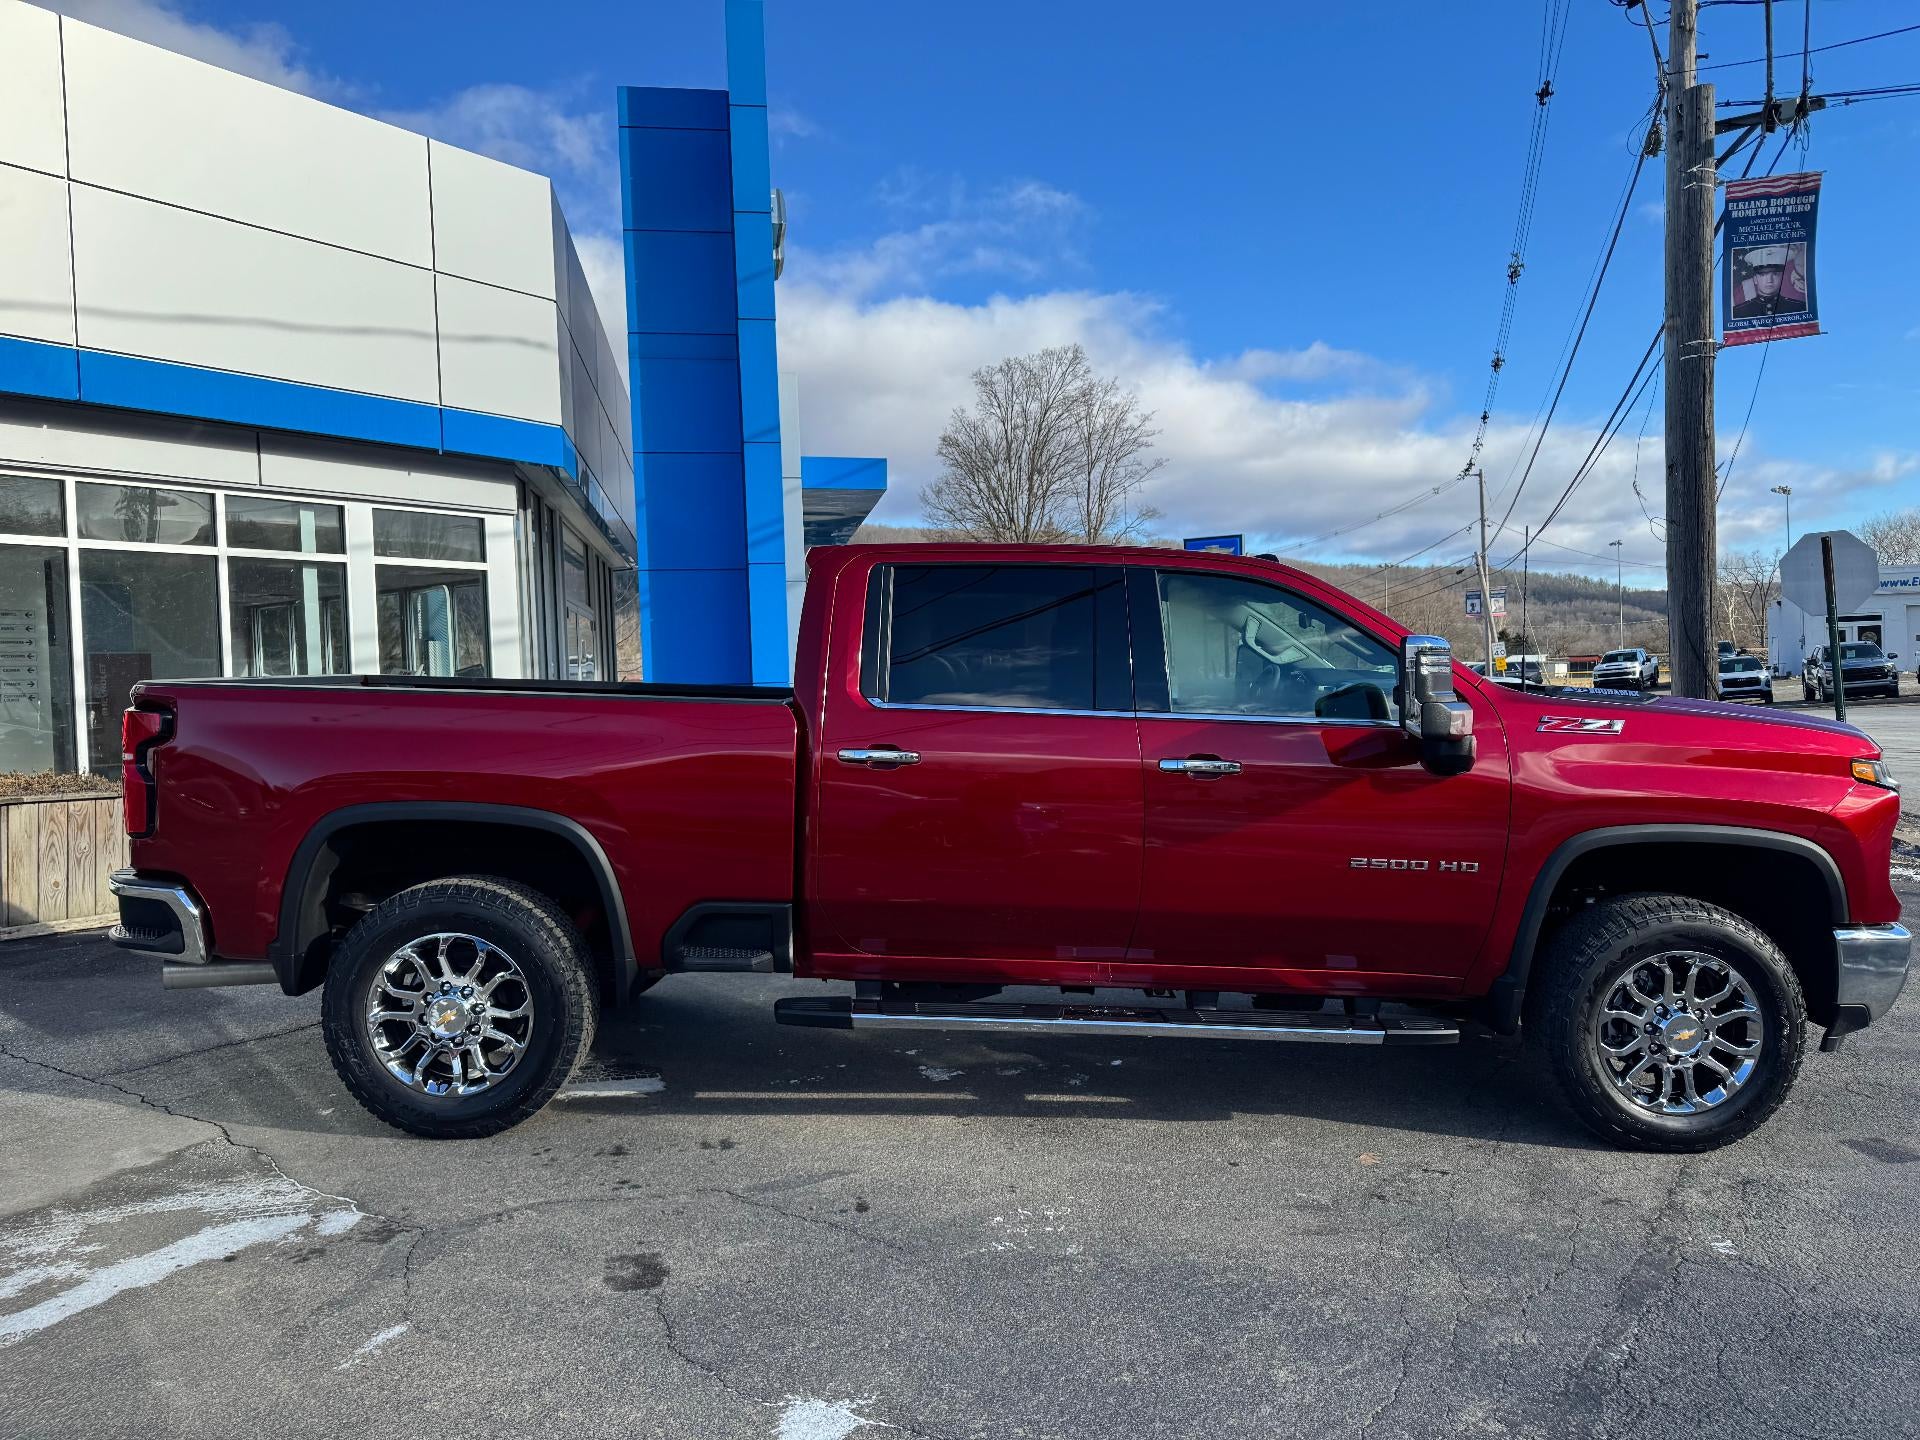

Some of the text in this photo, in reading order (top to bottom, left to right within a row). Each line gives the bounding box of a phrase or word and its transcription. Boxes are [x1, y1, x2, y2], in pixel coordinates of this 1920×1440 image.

[1728, 194, 1816, 211] ELKLAND BOROUGH
[1731, 204, 1811, 218] HOMETOWN HERO
[1738, 221, 1802, 233] MICHAEL PLANK
[1748, 232, 1779, 242] MARINE
[1780, 230, 1806, 239] CORPS
[1880, 577, 1920, 588] www.E
[1350, 857, 1479, 872] 2500 HD
